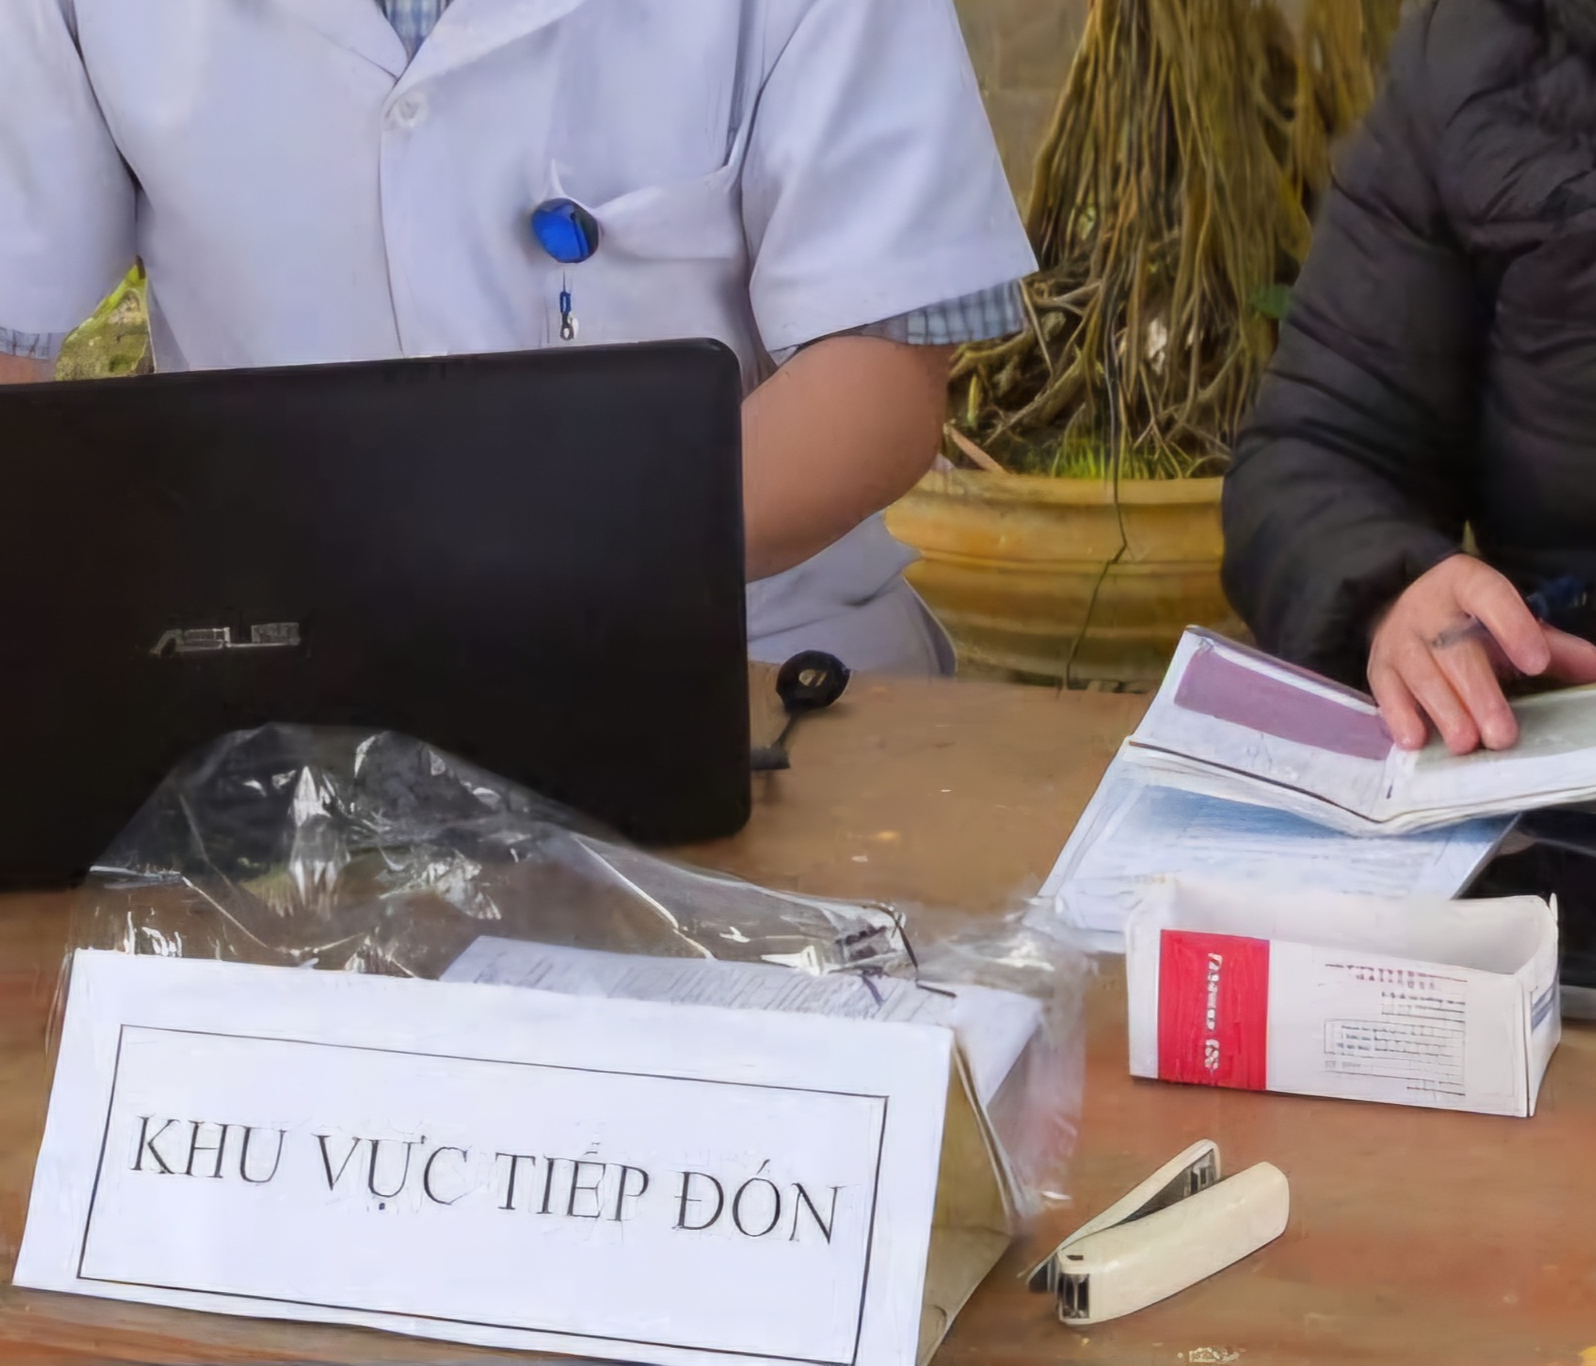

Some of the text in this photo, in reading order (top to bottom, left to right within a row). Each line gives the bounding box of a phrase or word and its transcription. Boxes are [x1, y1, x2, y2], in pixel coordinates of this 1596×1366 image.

[129, 1114, 852, 1246] KHU VỰC TIẾP ĐÓN
